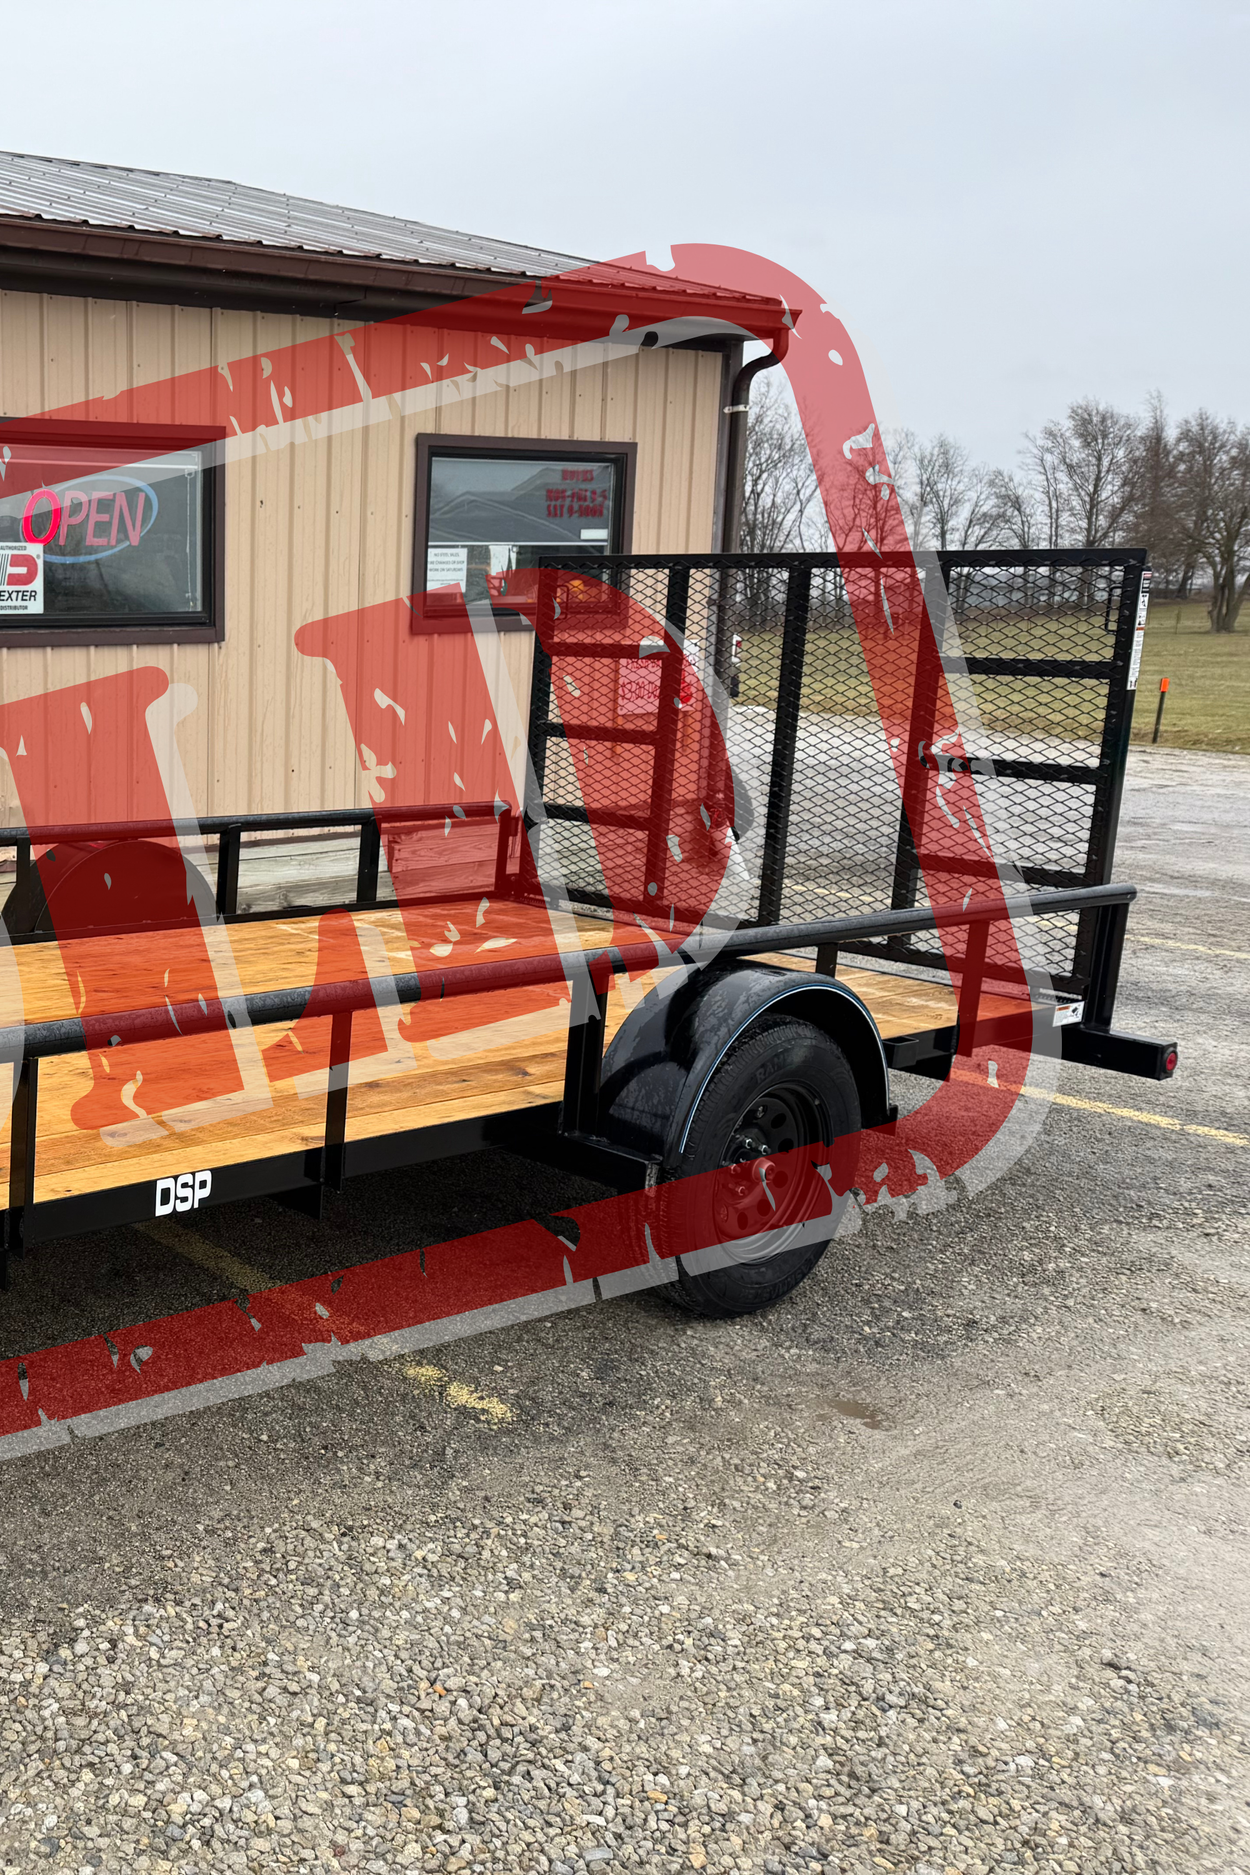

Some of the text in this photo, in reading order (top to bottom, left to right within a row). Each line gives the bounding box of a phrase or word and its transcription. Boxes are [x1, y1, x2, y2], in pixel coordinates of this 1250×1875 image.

[562, 469, 594, 482] HOURS
[22, 488, 146, 547] OPEN
[155, 1169, 213, 1217] DSP
